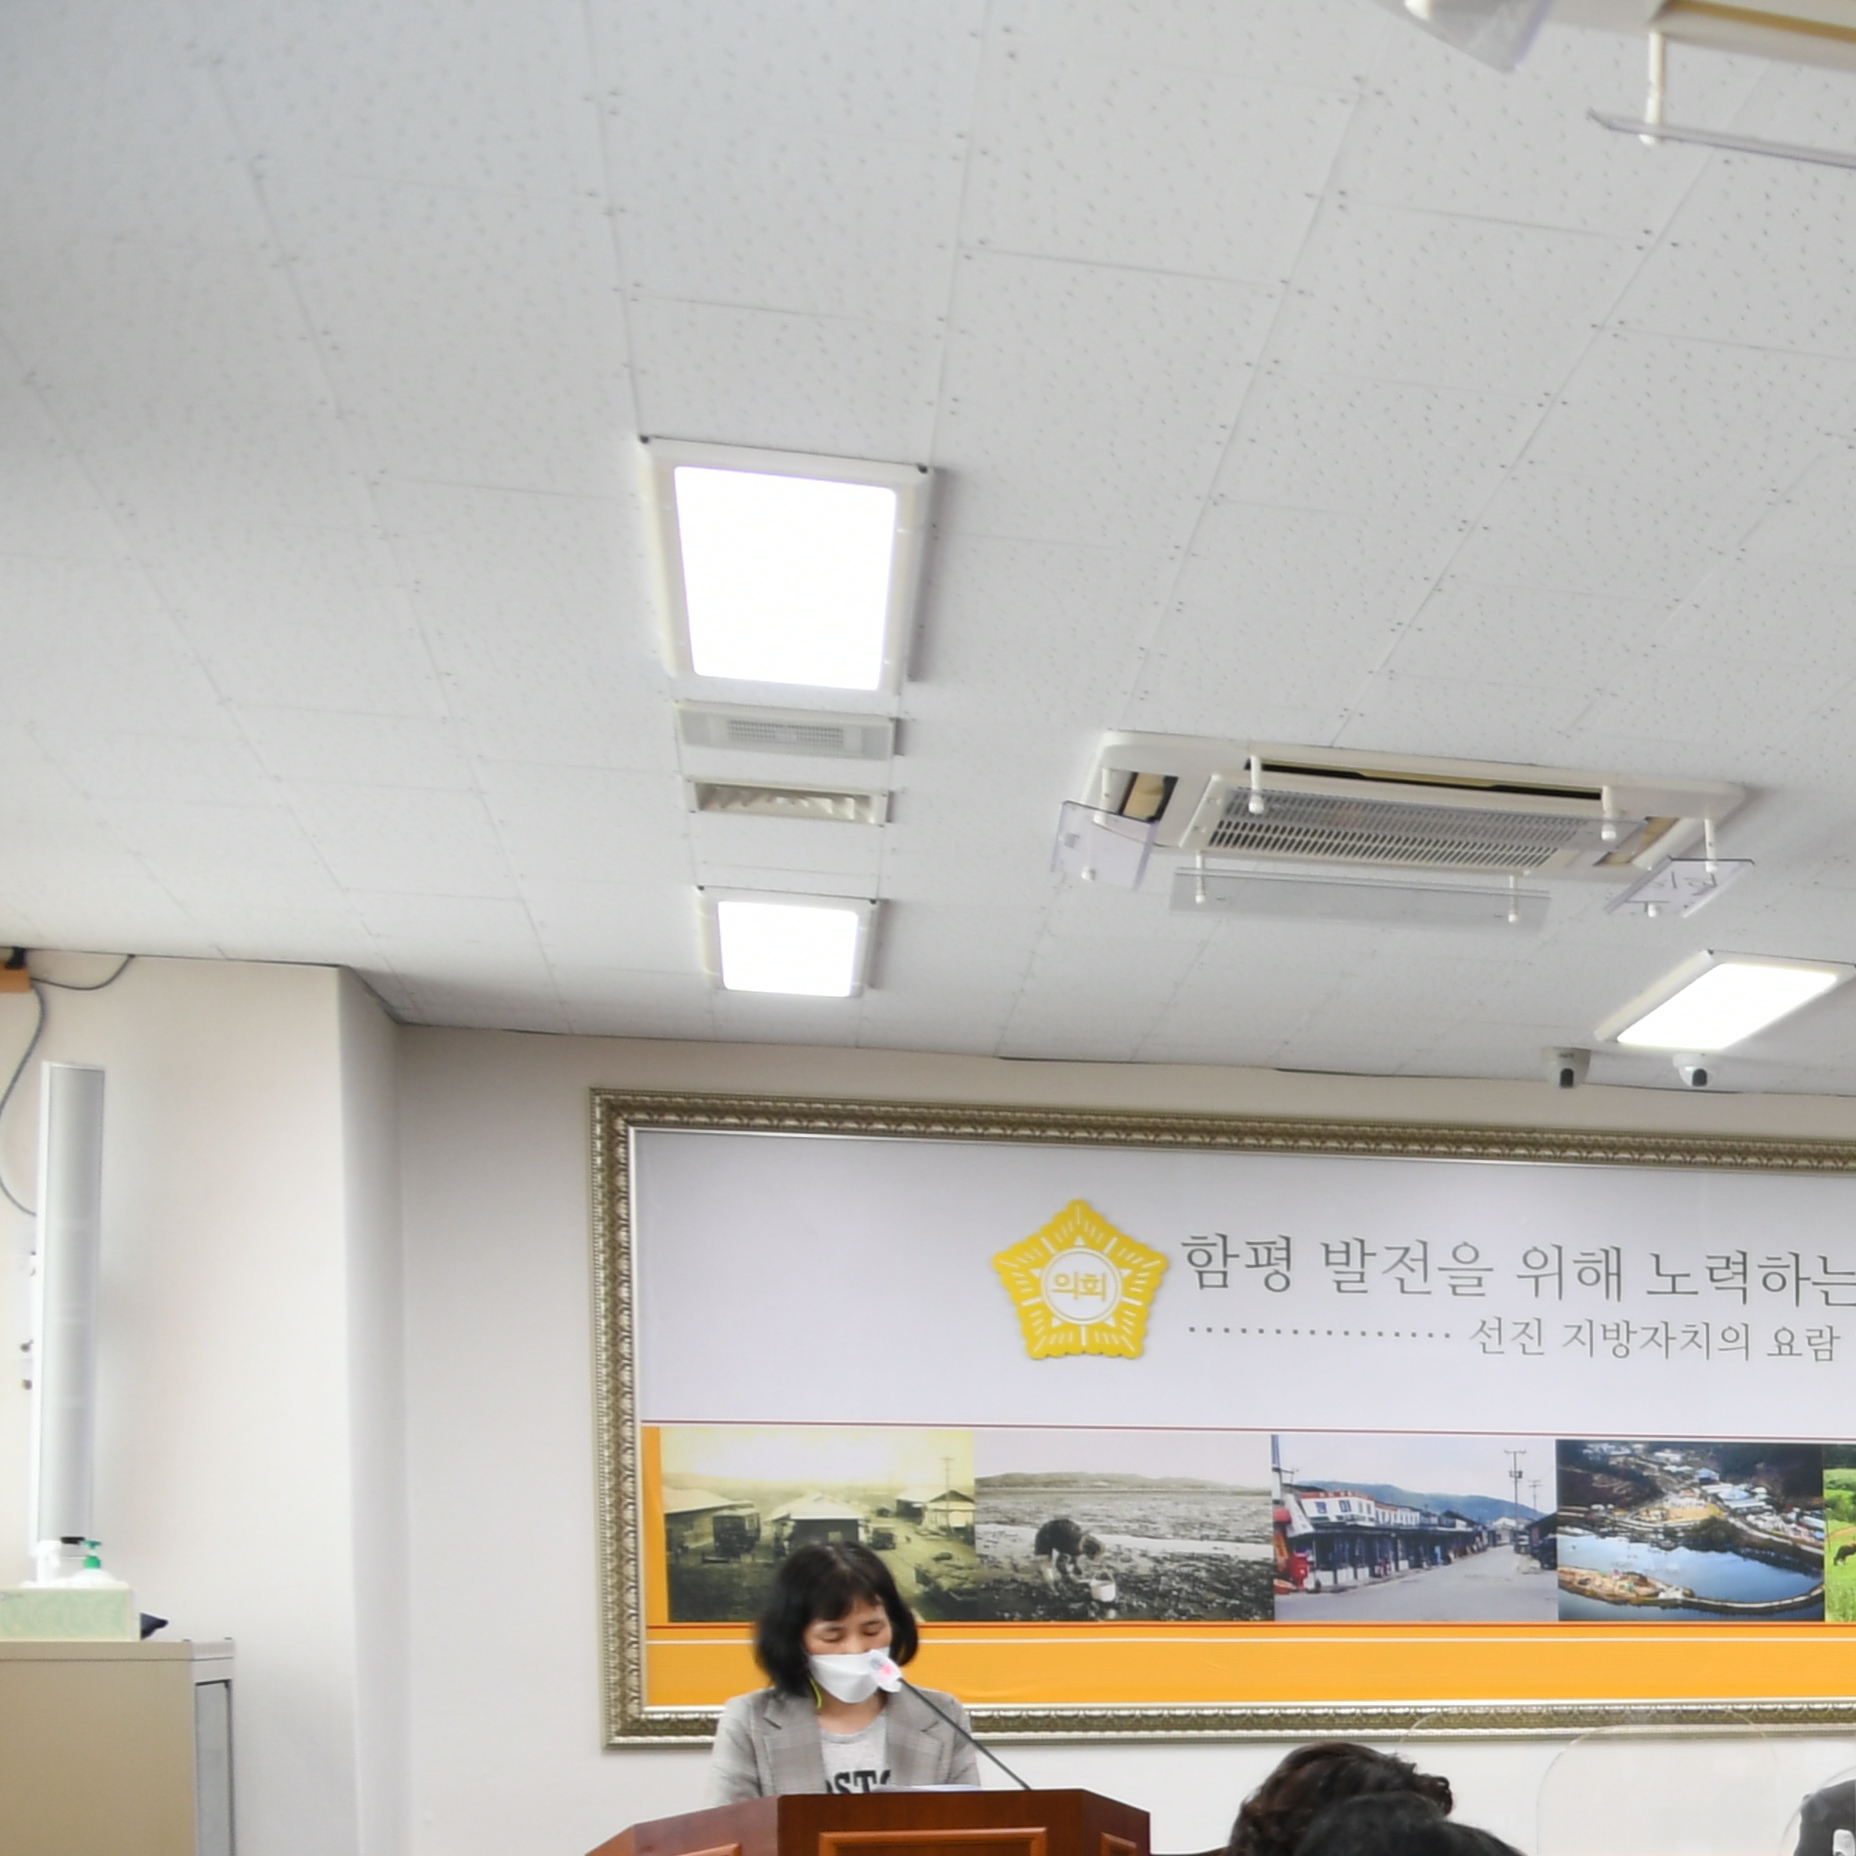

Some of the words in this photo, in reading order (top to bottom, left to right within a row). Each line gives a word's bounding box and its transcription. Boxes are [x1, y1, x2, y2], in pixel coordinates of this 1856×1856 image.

[1051, 1271, 1108, 1301] 의회
[1180, 1231, 1294, 1294] 함평
[1319, 1235, 1495, 1298] 발전을
[1516, 1243, 1622, 1303] 위해
[1469, 1315, 1546, 1356] 선진
[1561, 1317, 1751, 1362] 지방자치의
[1765, 1325, 1842, 1363] 요람
